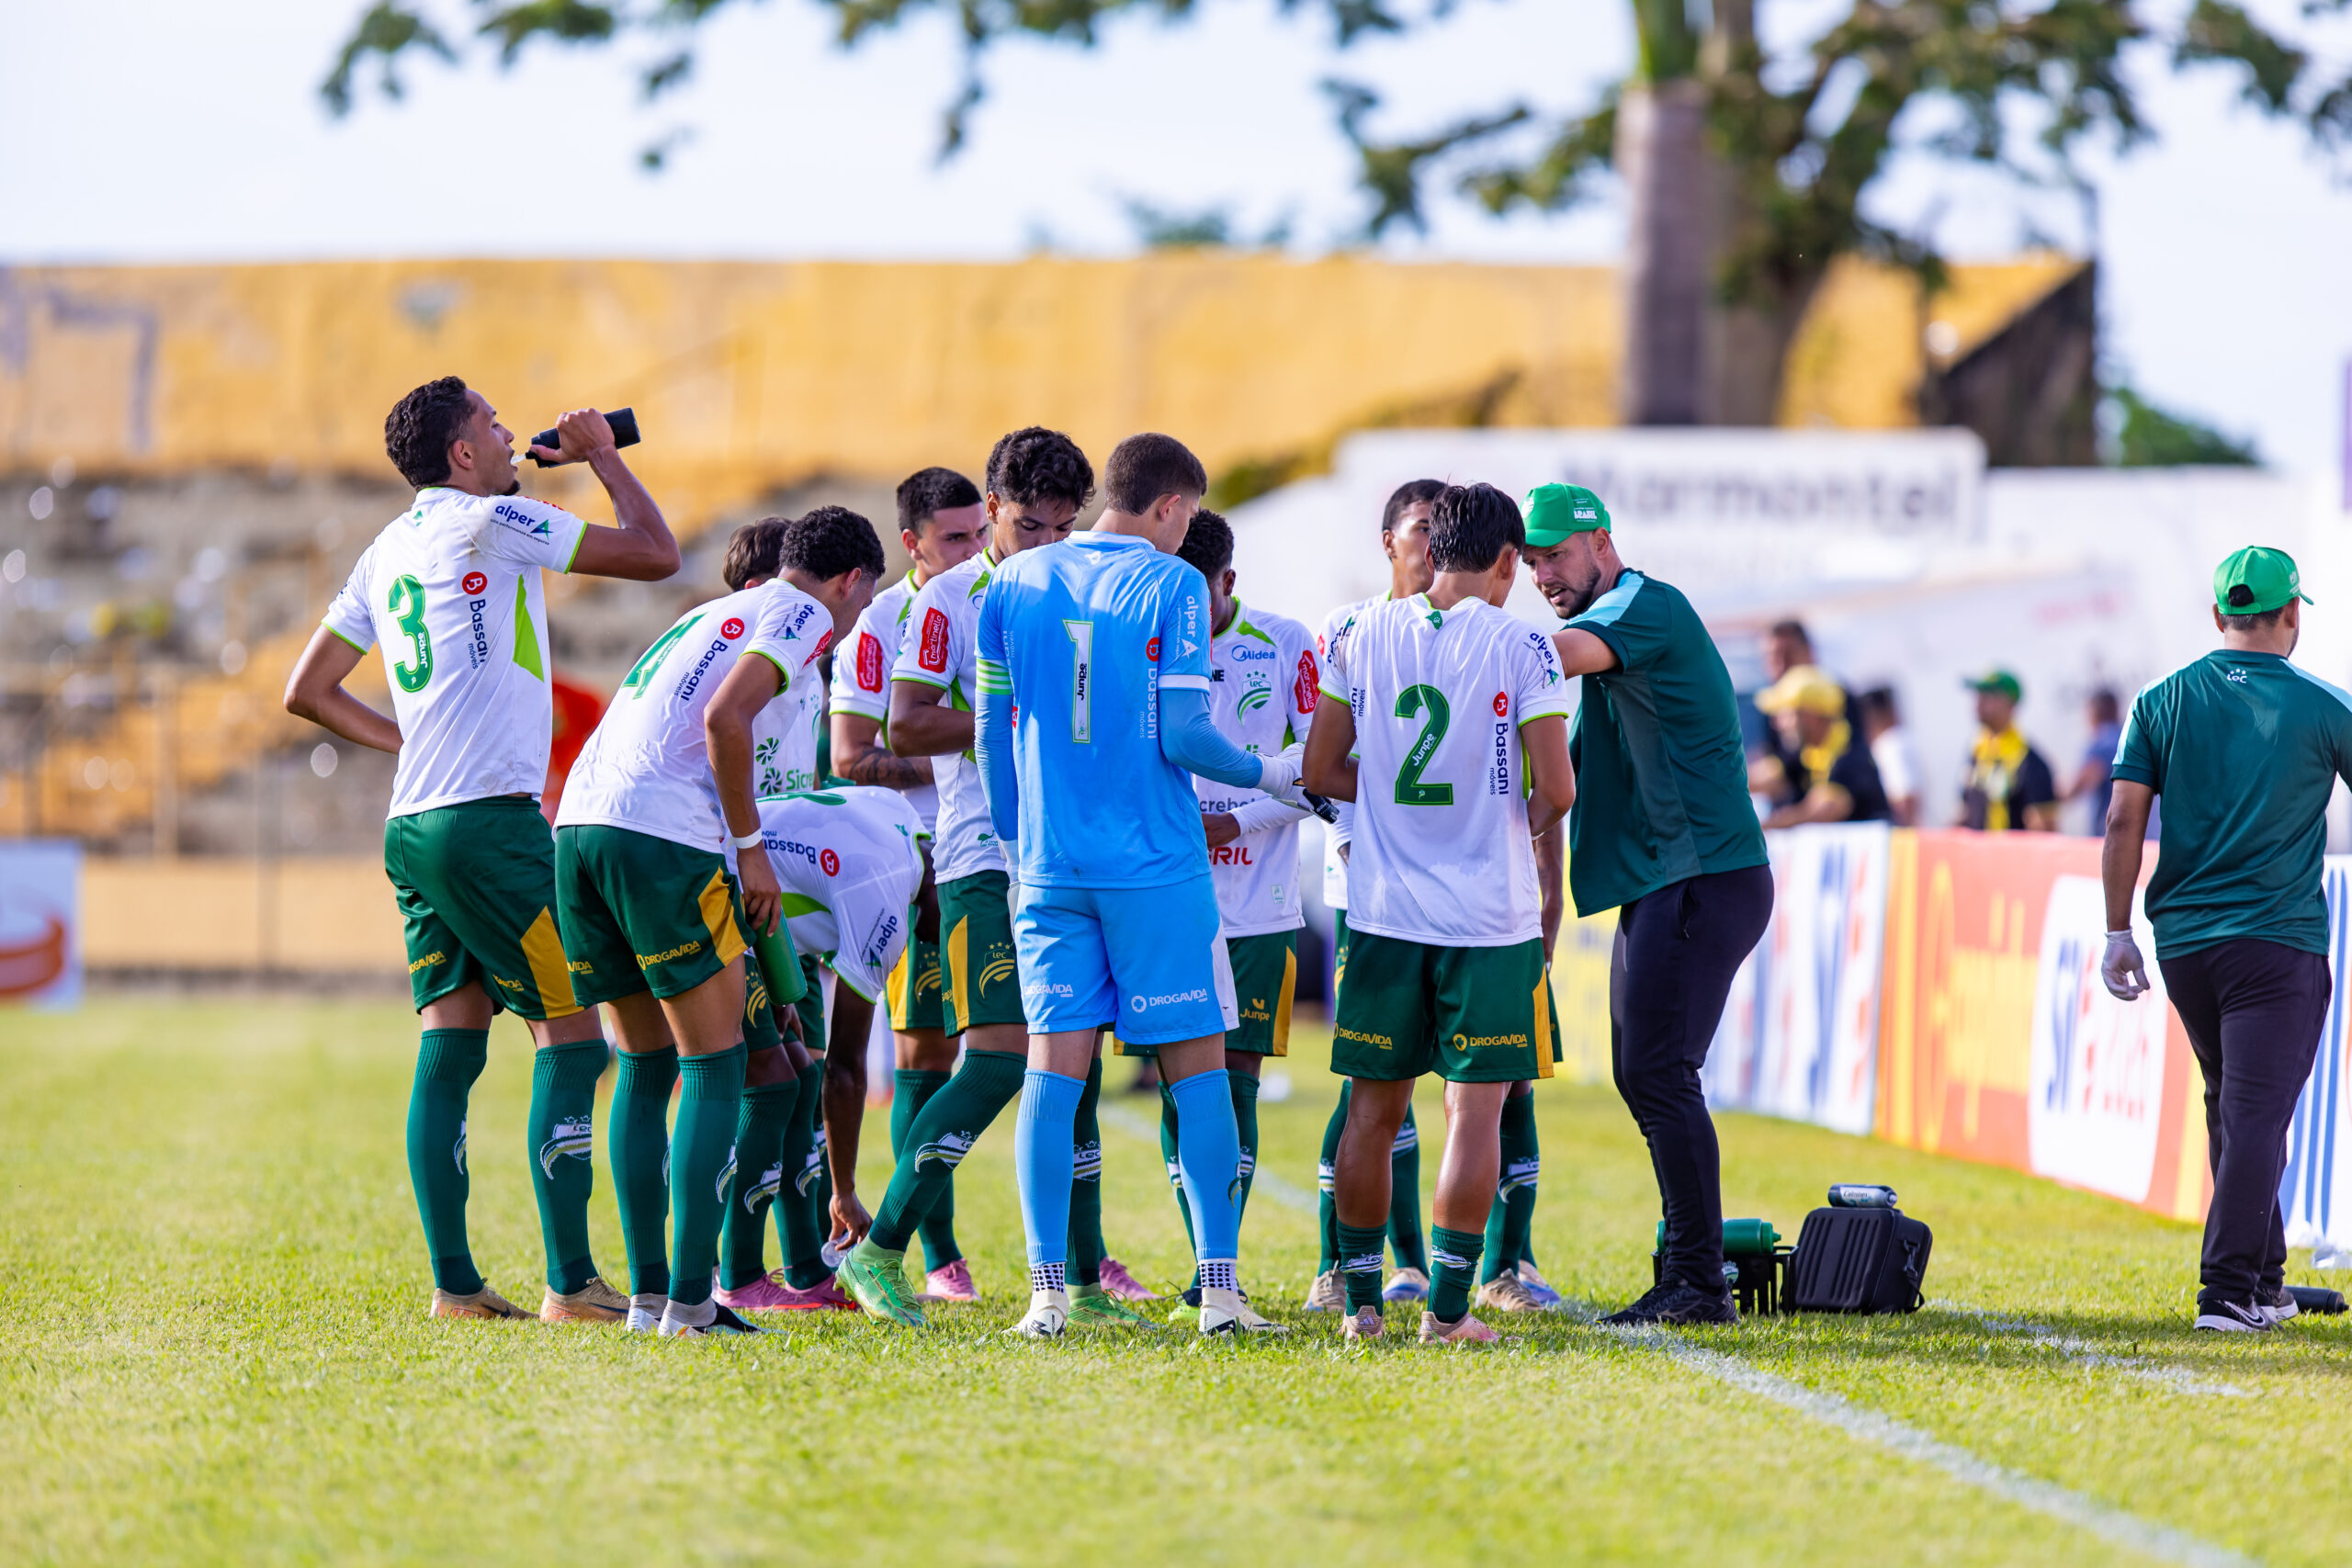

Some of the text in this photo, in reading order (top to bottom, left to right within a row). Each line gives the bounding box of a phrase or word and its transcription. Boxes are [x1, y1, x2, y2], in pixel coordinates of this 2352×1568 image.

[494, 504, 536, 527] alper
[1183, 595, 1199, 637] alper
[388, 574, 434, 694] 3
[417, 632, 428, 669] Junpe
[929, 615, 942, 660] martinello
[468, 643, 479, 670] móveis
[680, 639, 728, 701] Bassani
[1239, 650, 1275, 660] Midea
[673, 671, 690, 696] móveis
[1061, 619, 1094, 743] 1
[1077, 662, 1087, 701] Junpe
[1358, 689, 1366, 717] móveis
[1394, 683, 1453, 806] 2
[1411, 733, 1435, 767] Junpe
[1496, 722, 1510, 795] Bassani
[876, 915, 898, 953] alper
[645, 940, 701, 965] DROGAVIDA
[1148, 987, 1207, 1007] DROGAVIDA
[1239, 1008, 1271, 1021] Junpe
[1339, 1027, 1393, 1046] DROGAVIDA
[1470, 1033, 1528, 1046] DROGAVIDA
